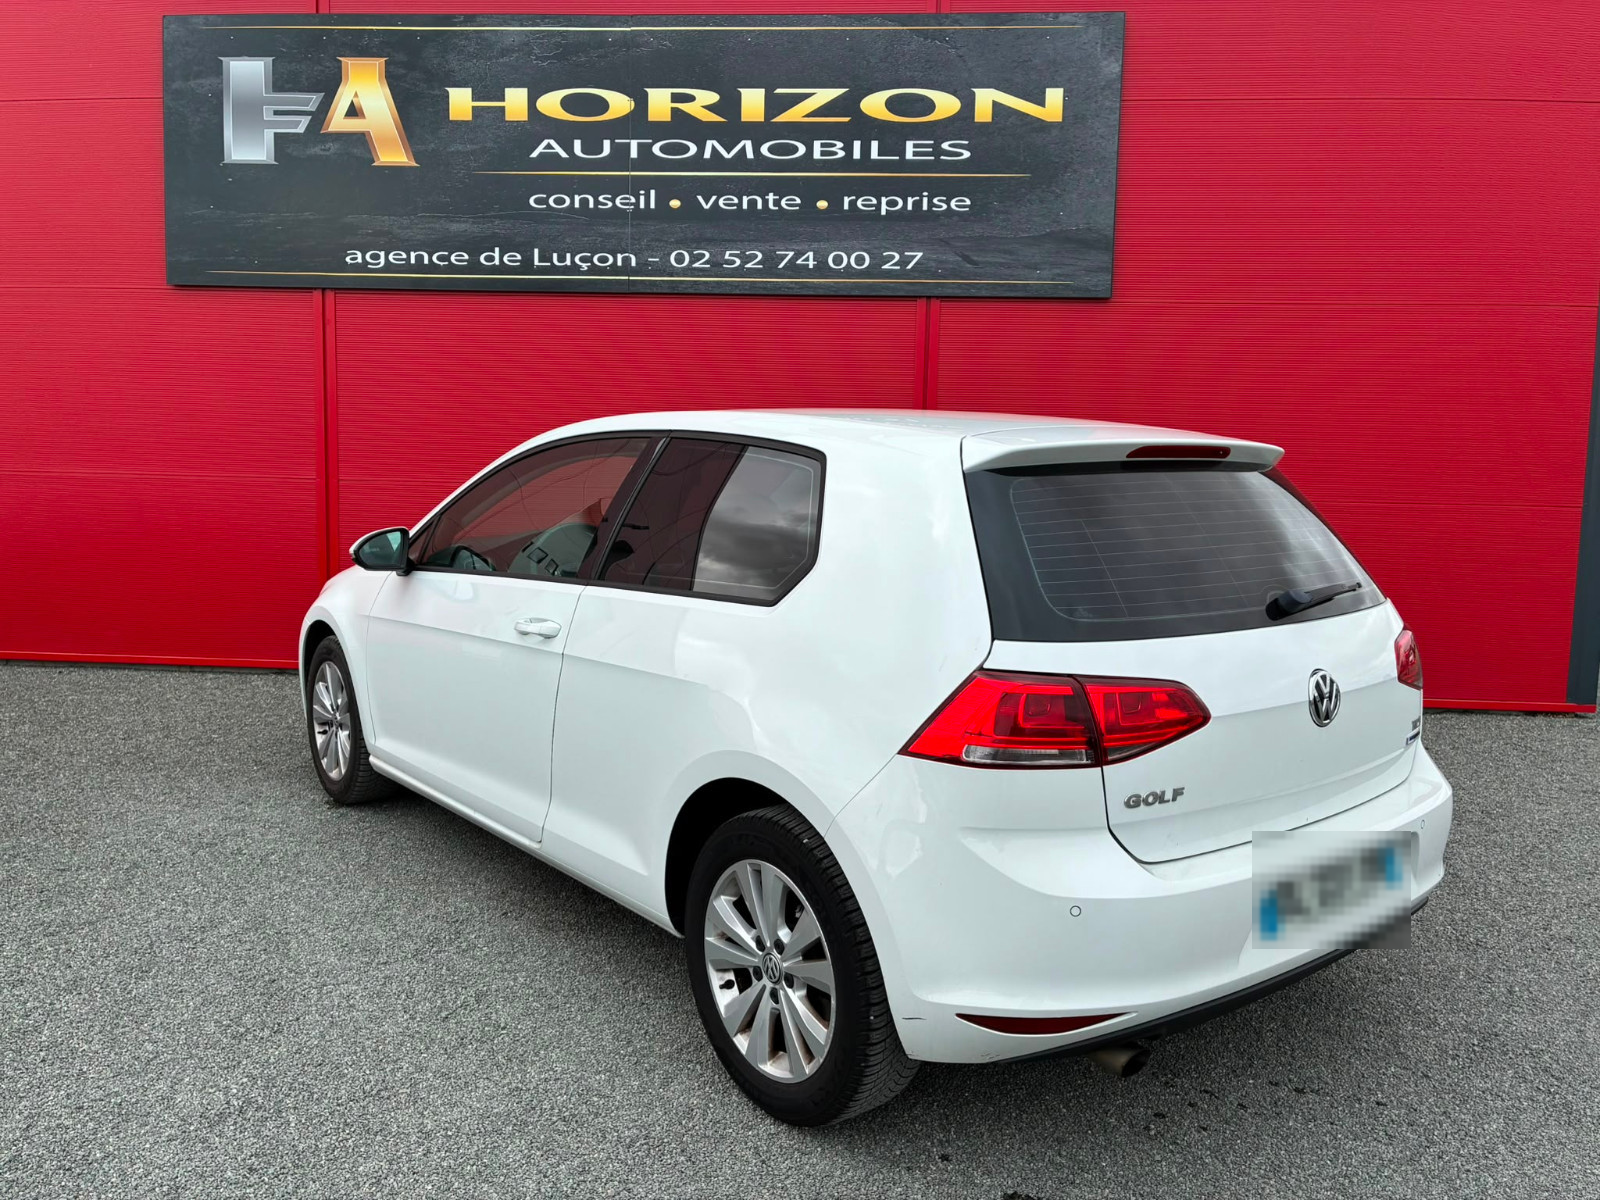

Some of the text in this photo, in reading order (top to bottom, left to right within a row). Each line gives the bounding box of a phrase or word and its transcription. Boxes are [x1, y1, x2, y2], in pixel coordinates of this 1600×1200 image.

[445, 87, 1064, 123] HORIZON
[529, 138, 972, 161] AUTOMOBILES
[528, 189, 972, 216] conseil vente reprise
[345, 249, 469, 269] agence
[479, 246, 521, 267] de
[533, 247, 637, 271] Luçon
[669, 249, 711, 269] 02
[722, 250, 764, 269] 52
[775, 251, 817, 269] 74
[827, 251, 871, 270] 00
[881, 251, 924, 270] 27
[1123, 787, 1185, 809] GOLF
